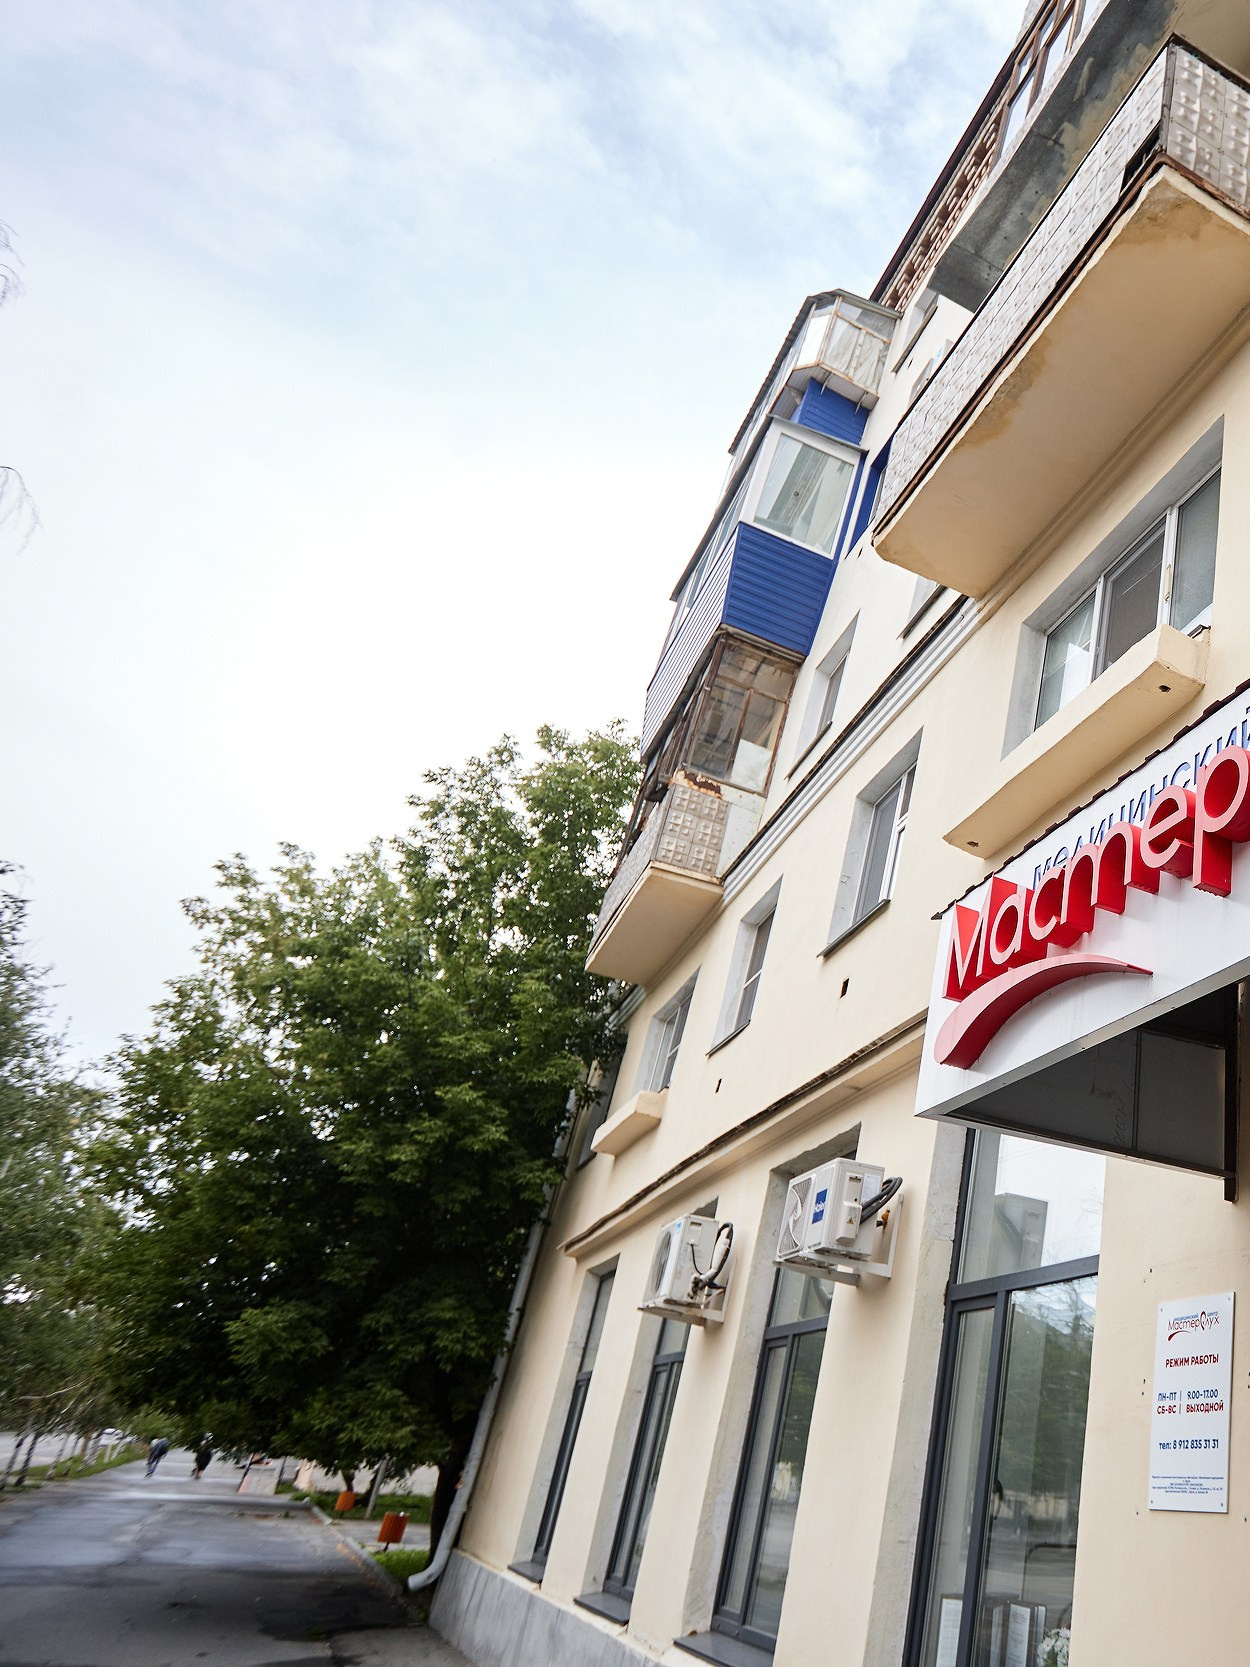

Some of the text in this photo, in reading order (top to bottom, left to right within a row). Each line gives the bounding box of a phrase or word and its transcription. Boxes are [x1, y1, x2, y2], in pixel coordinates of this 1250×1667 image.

[1165, 1354, 1219, 1368] РЕЖИМ РАБОТЫ
[1157, 1391, 1177, 1402] ПН-ПТ
[1156, 1400, 1224, 1415] СБ-ВС ВЫХОДНОЙ
[1158, 1438, 1219, 1450] тел: 8 912 835 31 31
